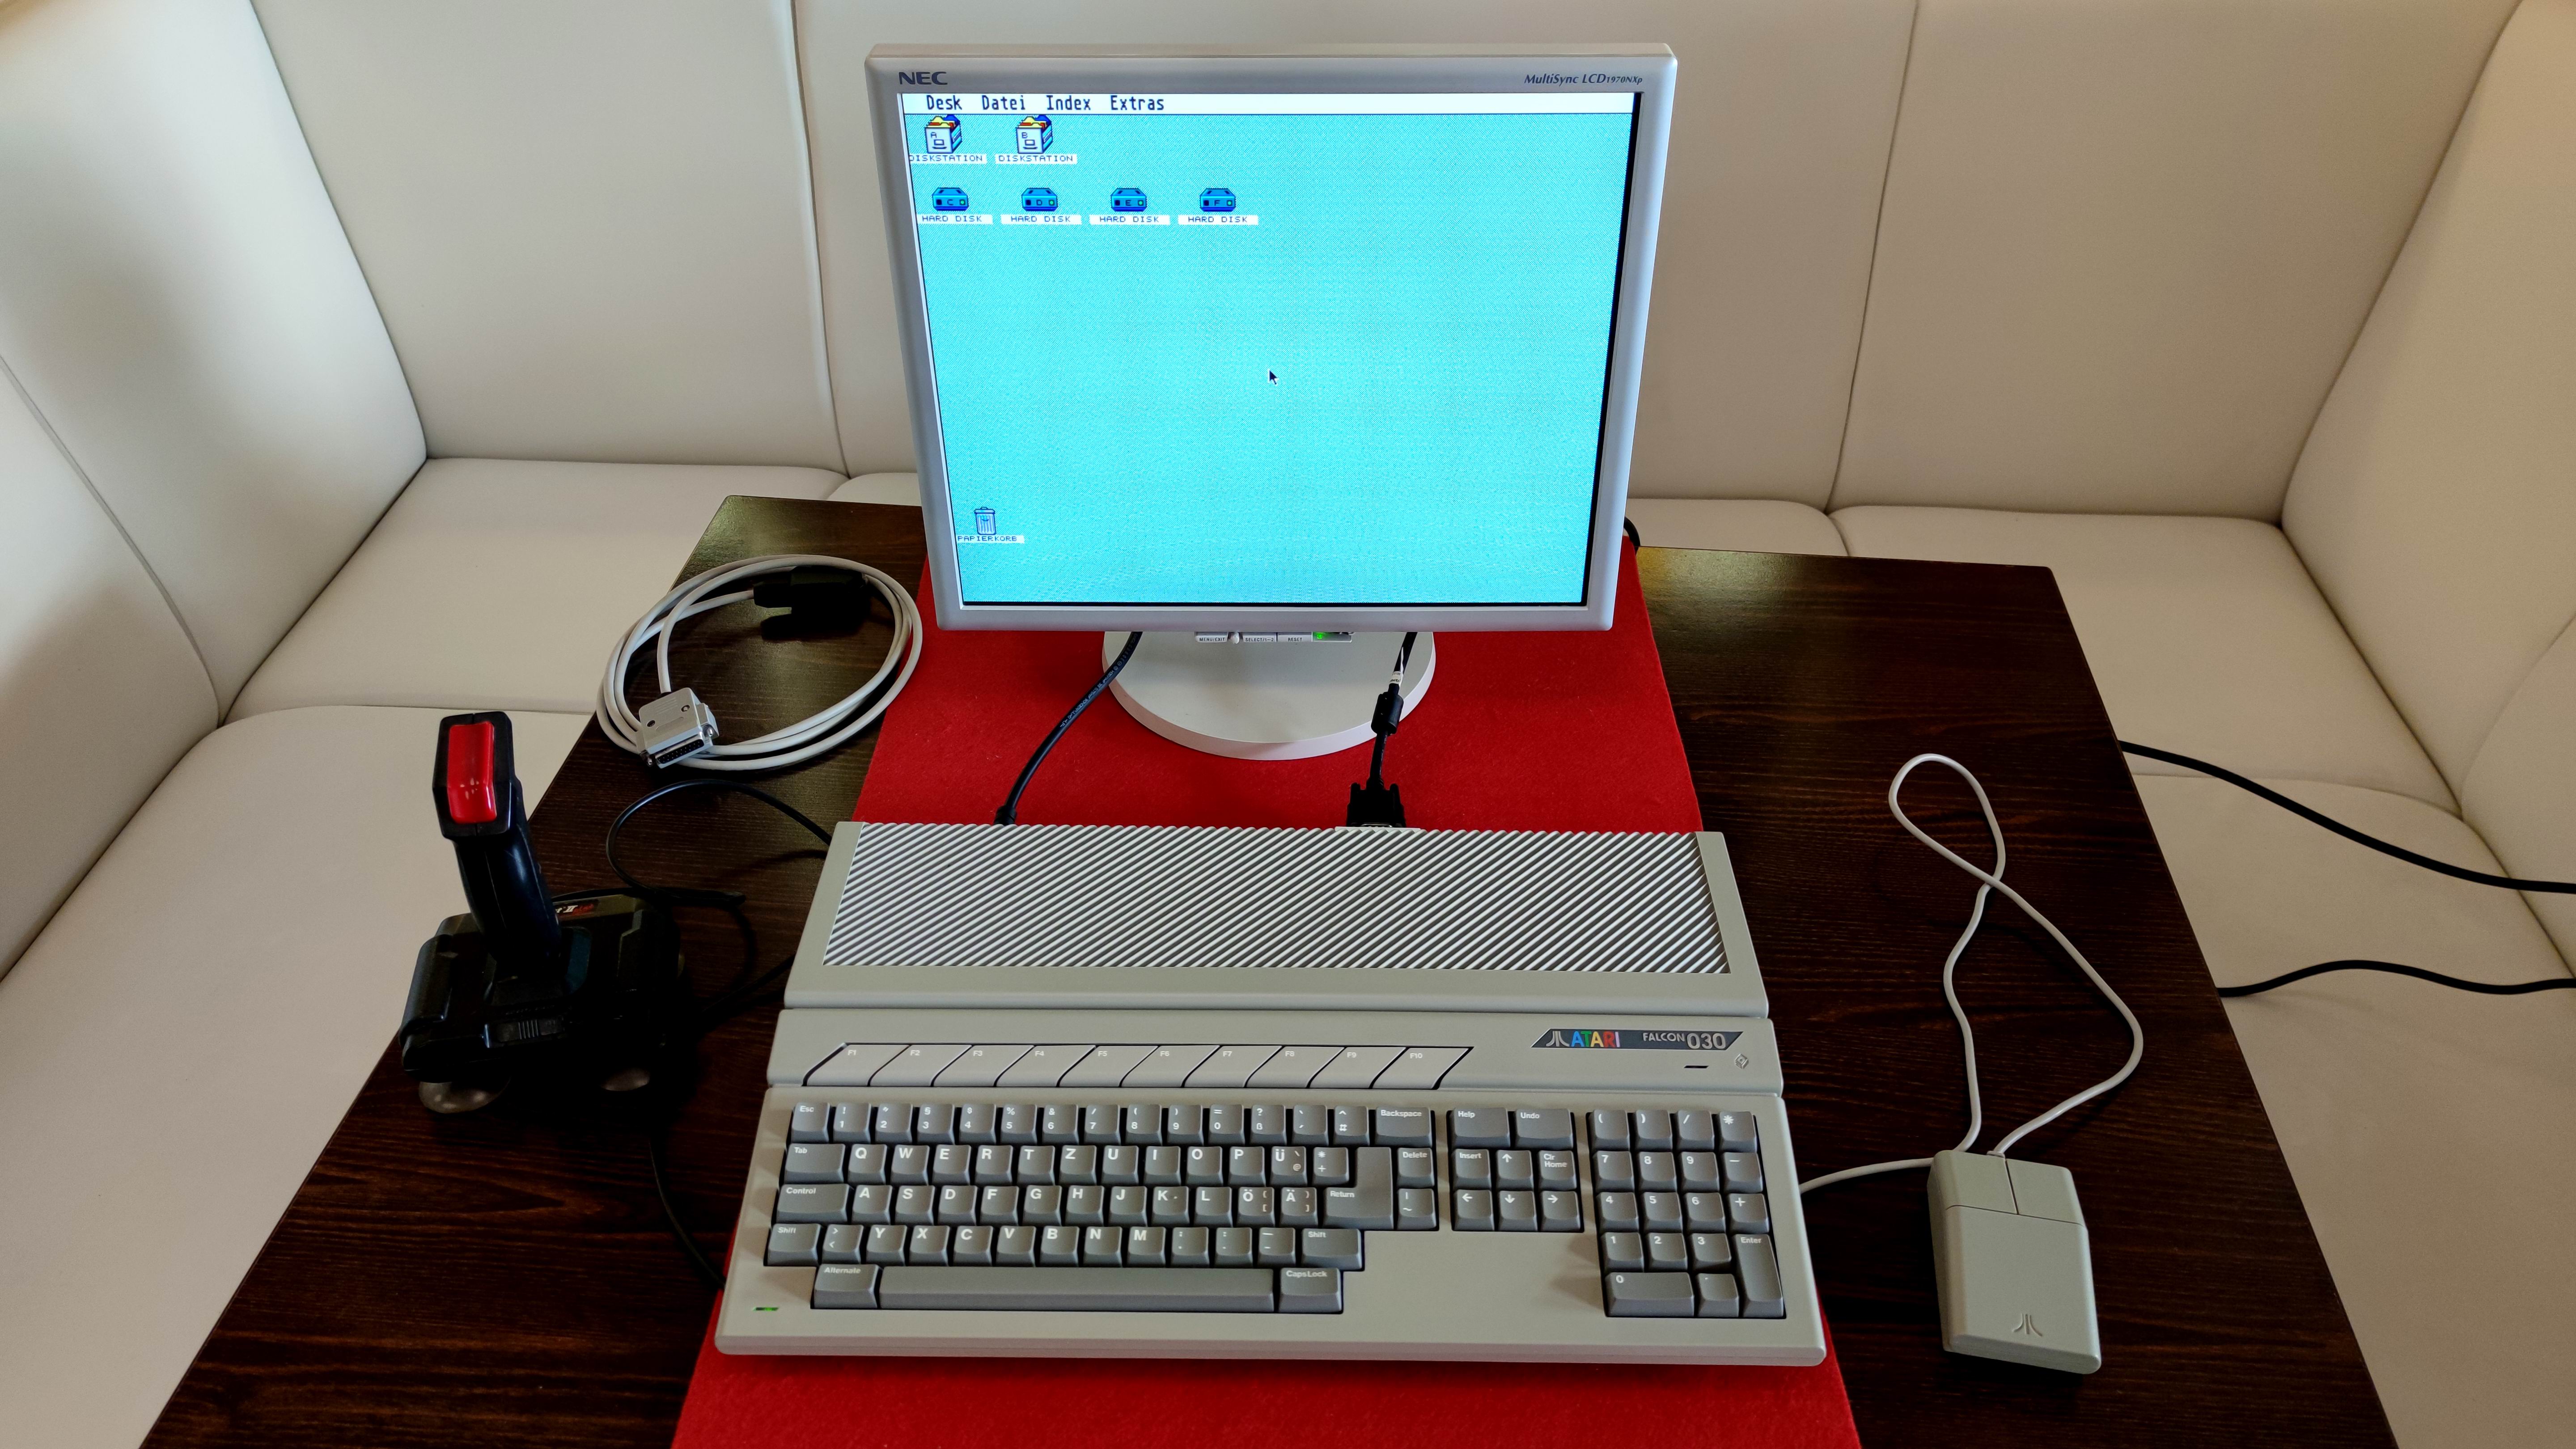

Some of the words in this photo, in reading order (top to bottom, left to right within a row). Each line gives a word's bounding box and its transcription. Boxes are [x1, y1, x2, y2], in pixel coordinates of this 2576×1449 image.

[898, 71, 948, 85] NEC
[1524, 73, 1579, 87] MultiSync
[926, 94, 962, 110] Desk
[981, 94, 1025, 110] Datei
[1046, 95, 1091, 110] Index
[1110, 95, 1165, 110] Extras
[1571, 1031, 1620, 1048] ATARI
[1642, 1032, 1685, 1042] FALCON
[1686, 1032, 1726, 1050] 030
[1006, 1107, 1015, 1115] %
[1256, 1108, 1263, 1116] ?
[1381, 1109, 1422, 1118] Backspace
[1457, 1110, 1475, 1119] Help
[880, 1120, 887, 1128] 2
[922, 1121, 929, 1129] 3
[964, 1121, 971, 1129] 4
[1006, 1121, 1013, 1129] 5
[1047, 1122, 1055, 1130] 6
[1089, 1122, 1097, 1130] 7
[1214, 1122, 1221, 1130] 0
[855, 1147, 867, 1159] Q
[898, 1147, 914, 1159] W
[939, 1148, 950, 1160] E
[981, 1148, 992, 1160] R
[1024, 1148, 1035, 1160] T
[1065, 1148, 1076, 1160] Z
[1107, 1148, 1119, 1160] U
[1191, 1148, 1203, 1160] O
[1234, 1149, 1244, 1160] P
[1275, 1148, 1285, 1162] Ü
[1601, 1154, 1609, 1163] 7
[1644, 1156, 1652, 1165] 8
[1686, 1156, 1694, 1165] 9
[1292, 1163, 1301, 1171] @
[859, 1187, 870, 1199] A
[902, 1188, 913, 1199] S
[944, 1188, 956, 1200] D
[987, 1188, 998, 1200] F
[1030, 1188, 1042, 1199] G
[1072, 1187, 1083, 1199] H
[1115, 1189, 1126, 1200] J
[1157, 1190, 1168, 1201] K
[1201, 1190, 1211, 1201] L
[1242, 1188, 1254, 1202] Ö
[1285, 1189, 1296, 1202] Ä
[1606, 1195, 1614, 1204] 4
[1649, 1195, 1657, 1204] 5
[1691, 1196, 1700, 1205] 6
[1734, 1197, 1746, 1207] +
[876, 1228, 886, 1238] Y
[916, 1228, 928, 1239] X
[960, 1228, 973, 1240] C
[1004, 1228, 1015, 1239] V
[1047, 1228, 1058, 1239] B
[1089, 1228, 1102, 1240] N
[1133, 1229, 1147, 1241] M
[1653, 1236, 1662, 1244] 2
[1697, 1236, 1705, 1245] 3
[1616, 1275, 1625, 1284] 0
